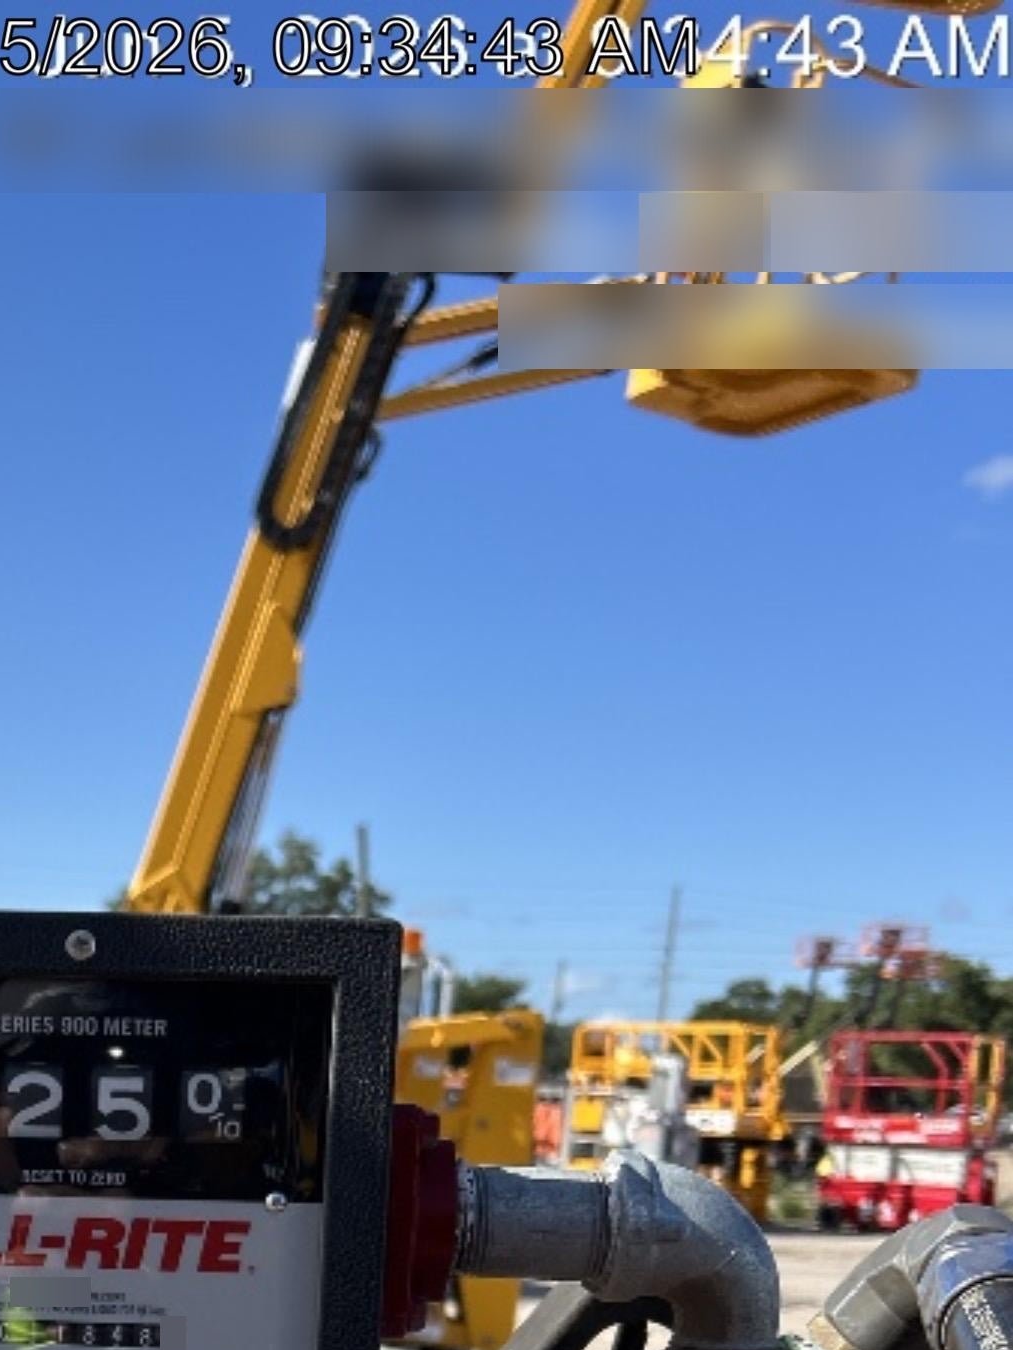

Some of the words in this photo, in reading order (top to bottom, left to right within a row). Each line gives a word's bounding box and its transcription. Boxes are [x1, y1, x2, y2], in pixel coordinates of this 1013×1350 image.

[61, 1015, 99, 1036] 900
[103, 1017, 169, 1038] METER
[69, 1169, 87, 1185] TO
